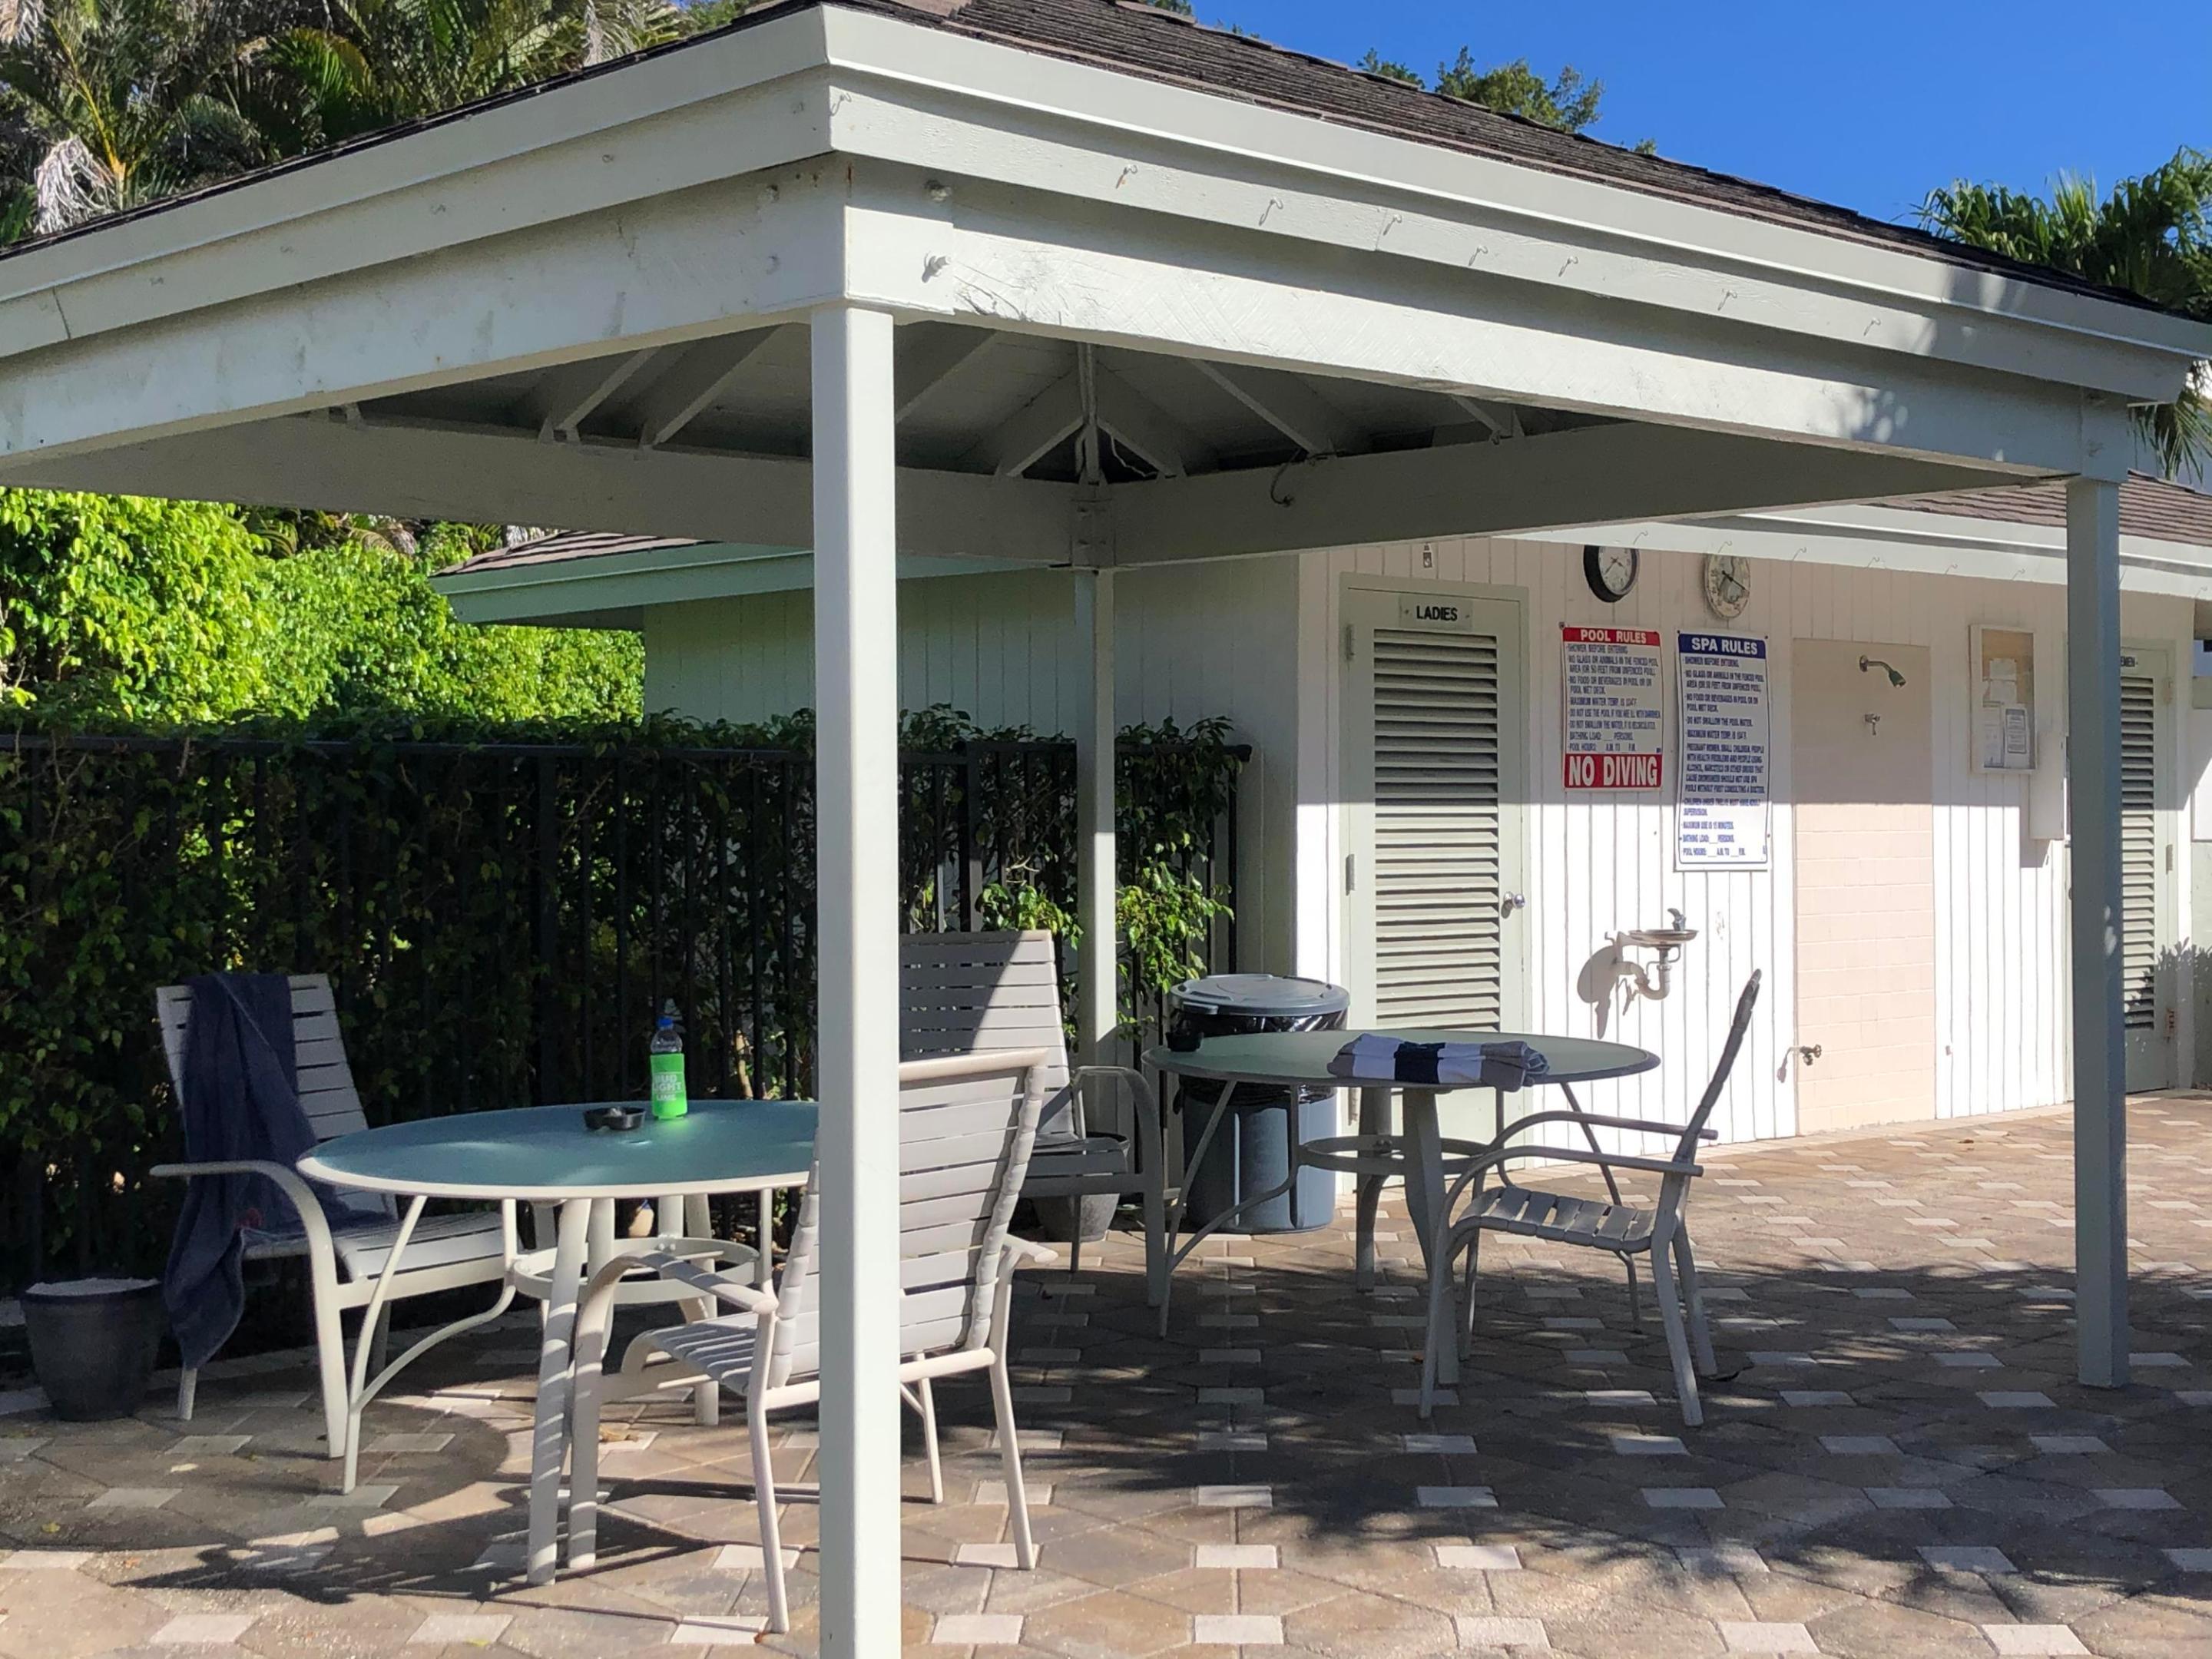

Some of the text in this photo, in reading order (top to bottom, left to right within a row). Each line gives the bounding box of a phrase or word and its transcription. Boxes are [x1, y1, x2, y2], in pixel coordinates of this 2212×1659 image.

[1416, 605, 1458, 621] LADIES
[1581, 630, 1647, 644] POOL RULES
[1691, 637, 1757, 655] SPA RULES
[1569, 756, 1657, 786] NO DIVING
